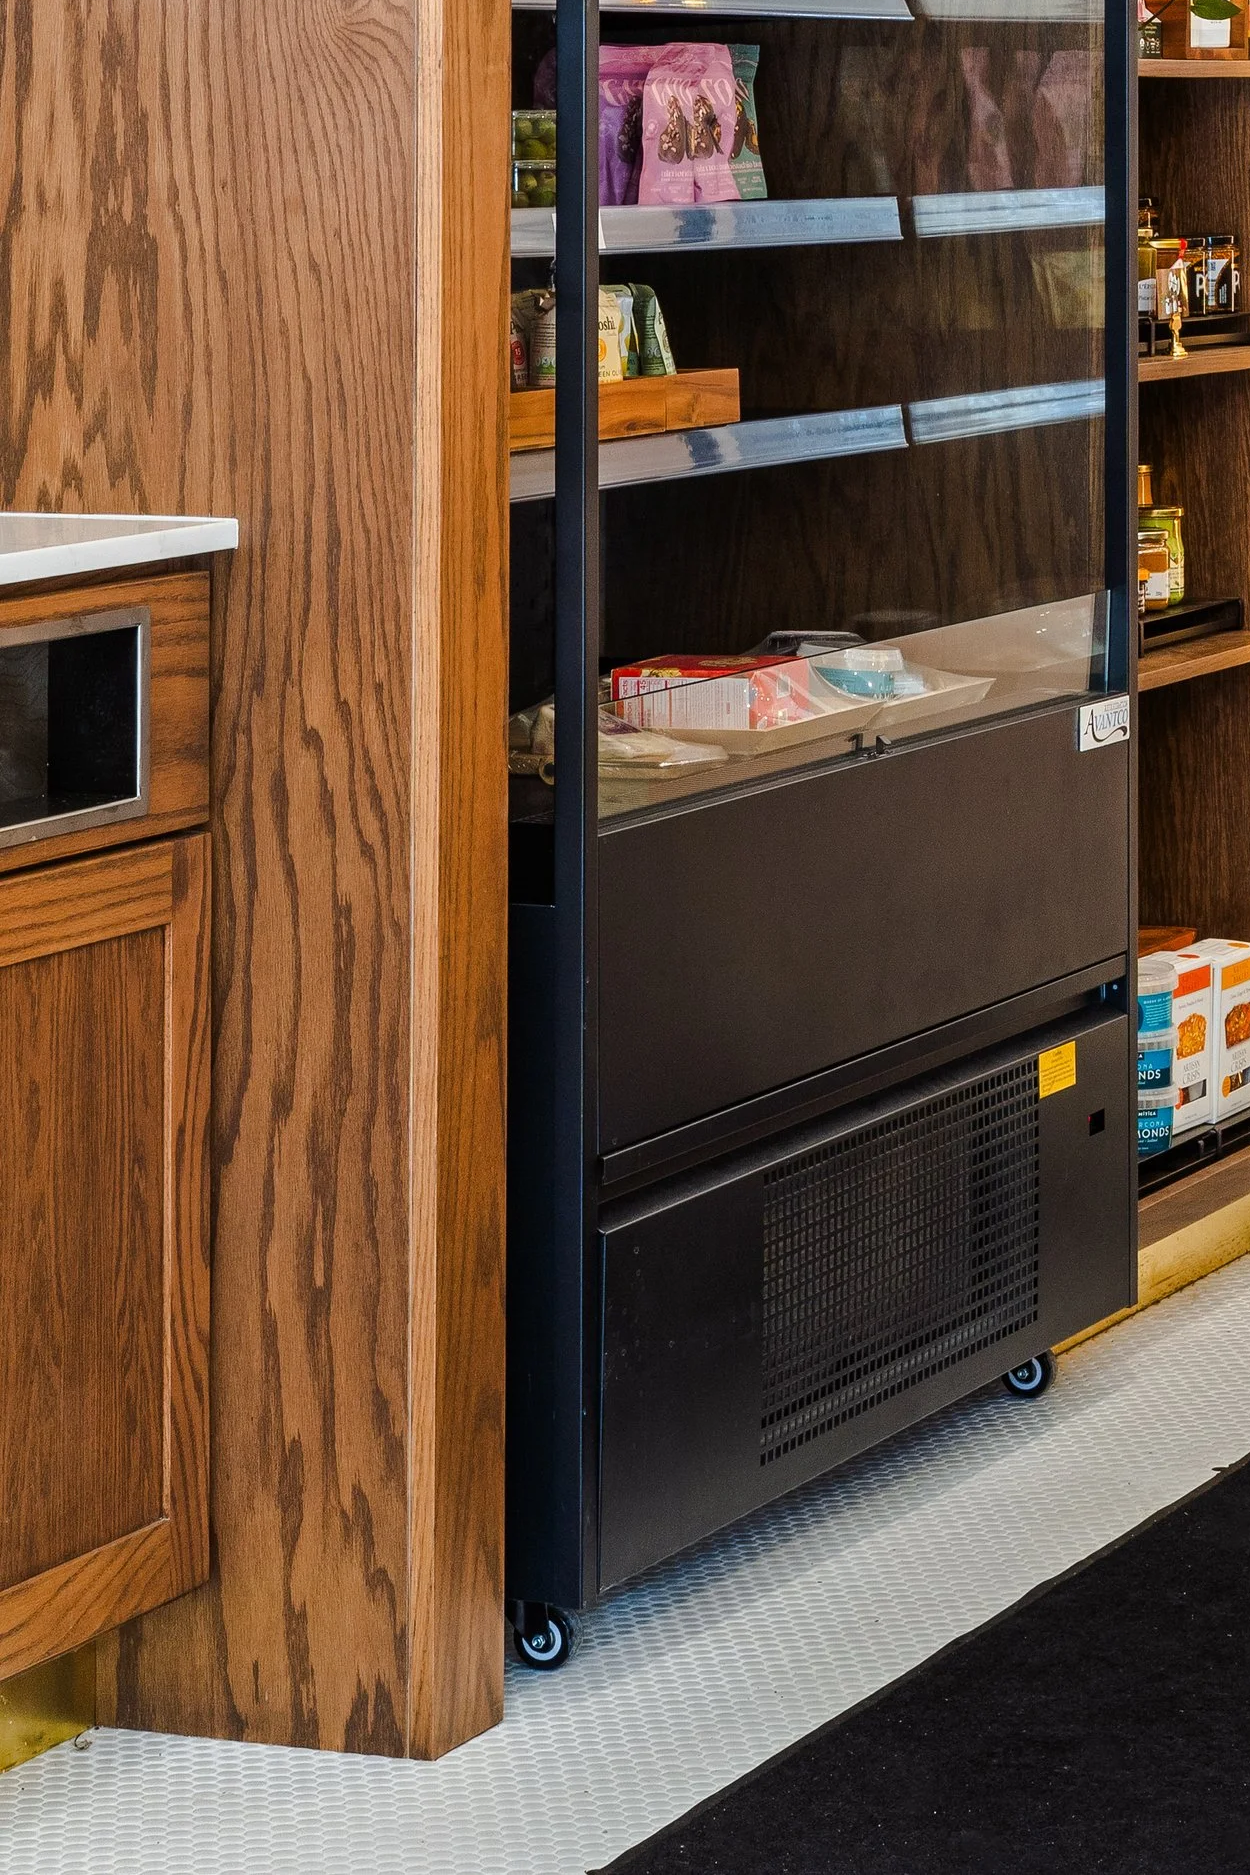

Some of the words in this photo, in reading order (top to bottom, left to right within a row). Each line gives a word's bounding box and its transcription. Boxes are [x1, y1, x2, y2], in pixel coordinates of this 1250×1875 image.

[1083, 708, 1129, 743] AVANTCO
[1230, 1059, 1247, 1073] CRISPS
[1182, 1070, 1201, 1085] CRISPS
